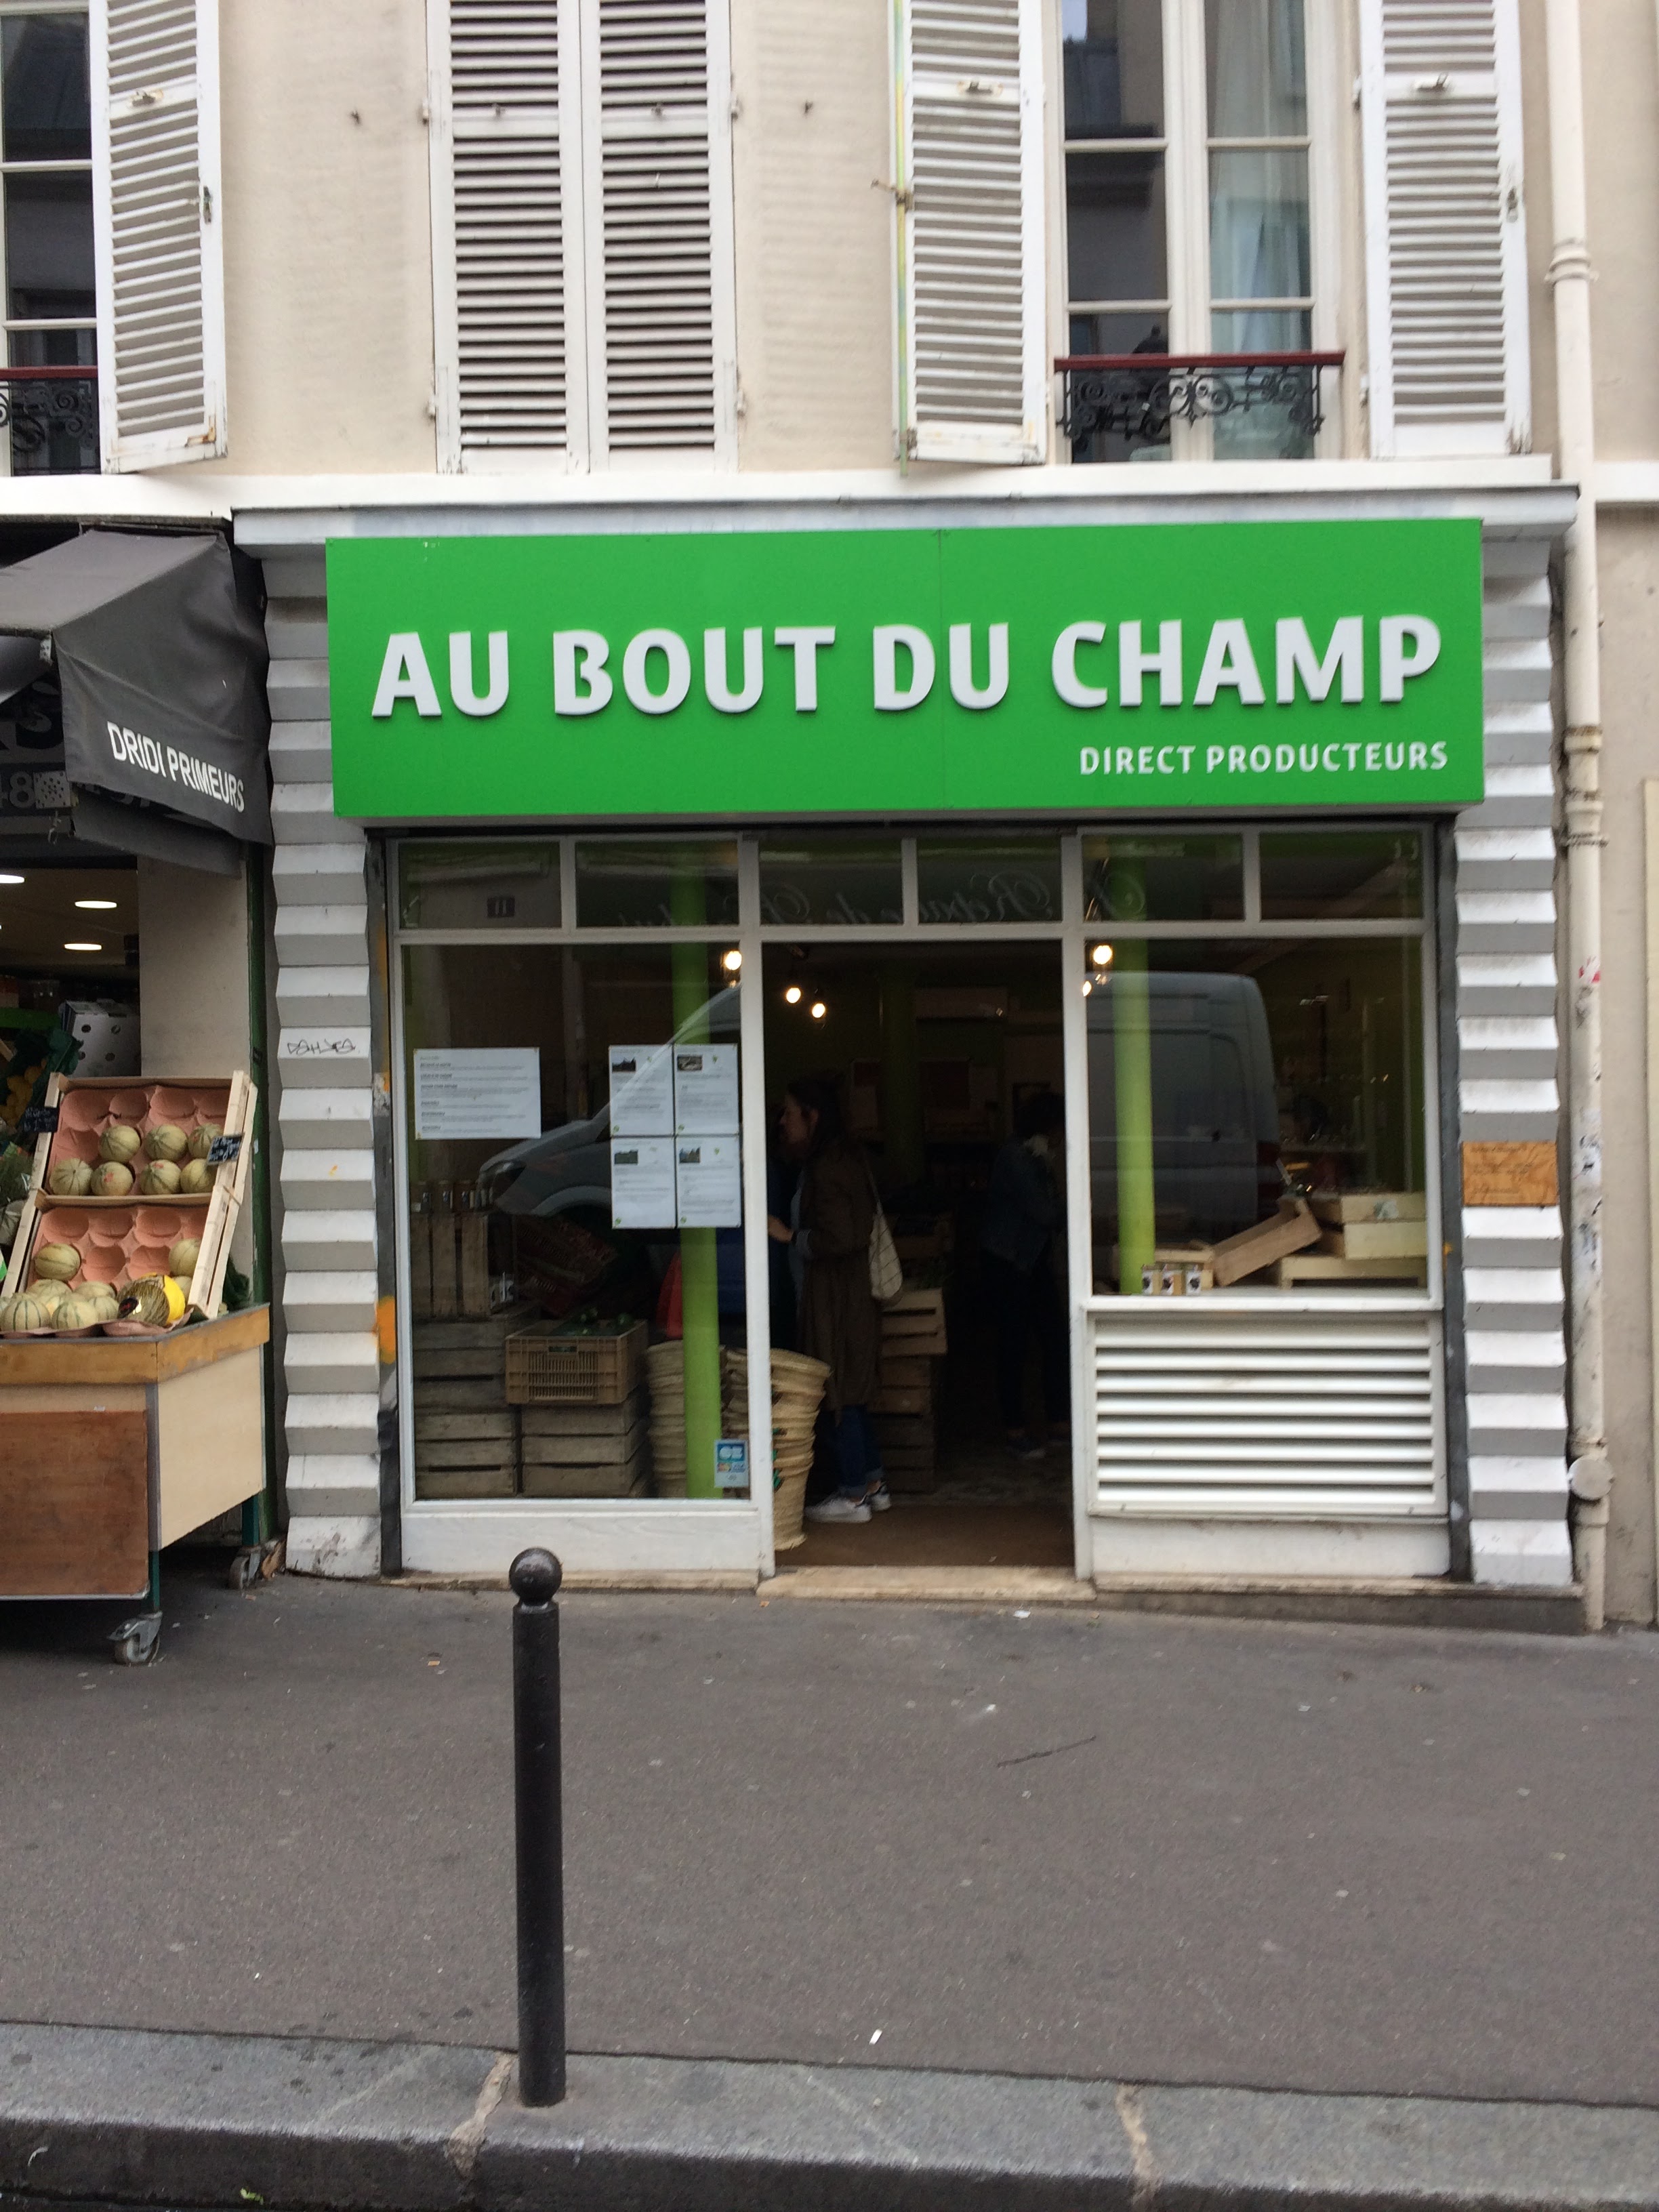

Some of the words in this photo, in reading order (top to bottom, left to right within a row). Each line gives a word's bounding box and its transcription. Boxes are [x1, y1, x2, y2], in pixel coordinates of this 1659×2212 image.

[371, 630, 510, 717] AU
[552, 626, 836, 715] BOUT
[872, 622, 1010, 710] DU
[1051, 615, 1441, 708] CHAMP
[107, 721, 167, 777] DRIDI
[167, 745, 245, 813] PRIMEURS
[1080, 746, 1196, 775] DIRECT
[1206, 741, 1448, 773] PRODUCTEURS
